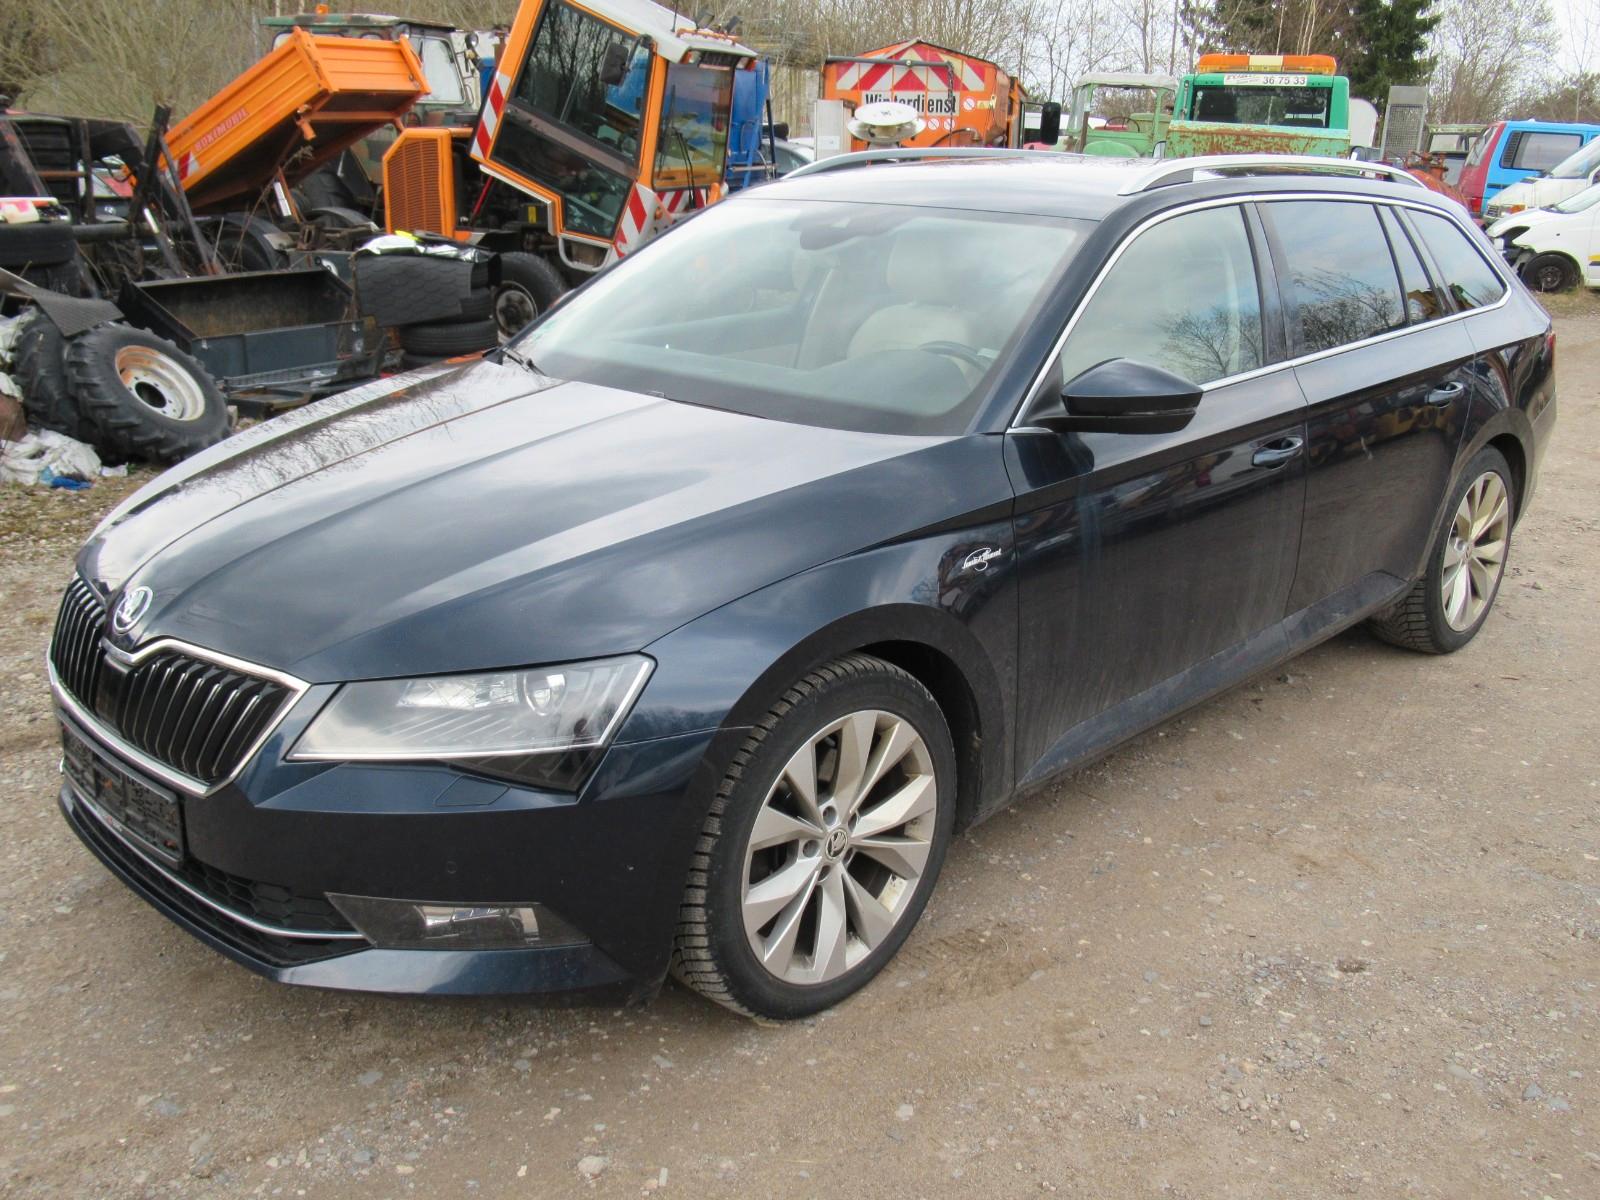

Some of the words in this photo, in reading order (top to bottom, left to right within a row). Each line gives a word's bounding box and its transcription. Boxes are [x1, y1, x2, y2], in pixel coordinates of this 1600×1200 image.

[1263, 76, 1275, 84] 36
[1278, 77, 1290, 85] 75
[1293, 77, 1306, 85] 33
[865, 93, 957, 114] Wrdienst
